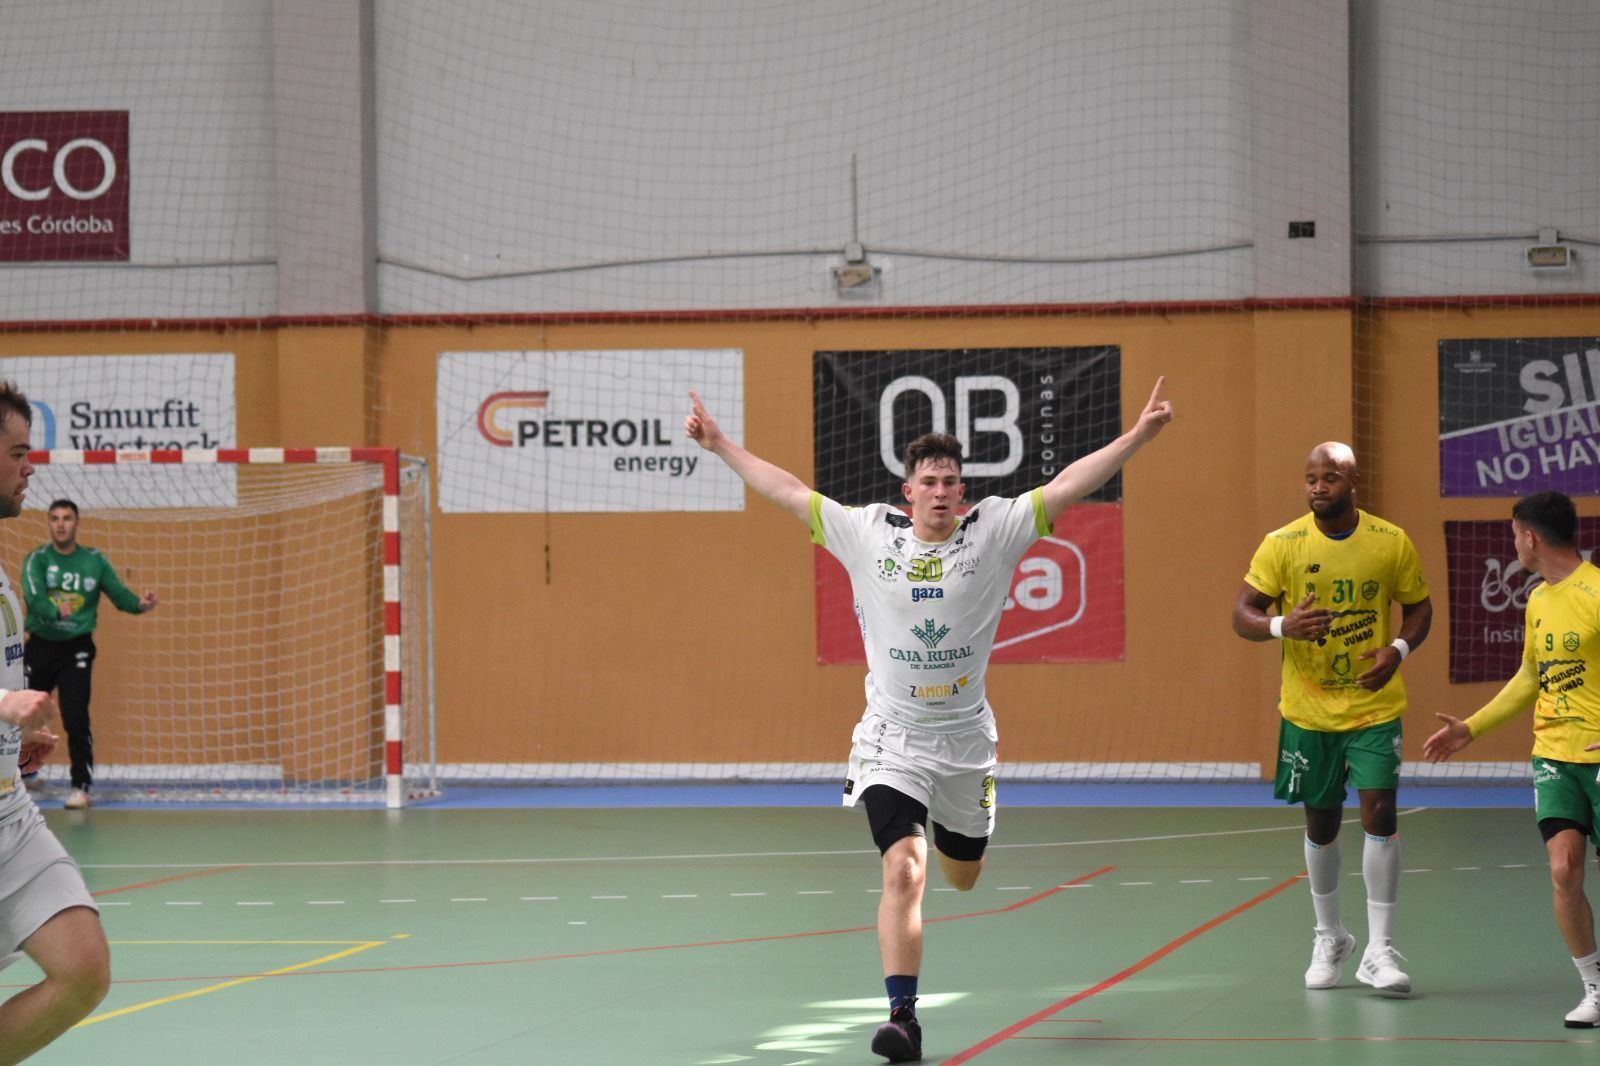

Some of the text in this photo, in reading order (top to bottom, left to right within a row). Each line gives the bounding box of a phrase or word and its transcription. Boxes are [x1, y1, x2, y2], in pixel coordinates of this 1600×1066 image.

[27, 214, 114, 234] Córdoba
[70, 400, 200, 430] Smurfit
[1040, 374, 1055, 476] cocinas
[518, 419, 672, 447] PETROIL
[879, 375, 1024, 479] OB
[613, 453, 698, 477] energy
[1476, 452, 1531, 487] NO
[907, 557, 942, 582] 30
[61, 571, 81, 591] 21
[1332, 579, 1354, 604] 31
[912, 587, 944, 602] gaza
[1343, 628, 1374, 647] JUMBO
[1546, 633, 1554, 652] 9
[889, 645, 974, 662] CAJA RURAL
[923, 662, 956, 670] ZAMORA
[910, 683, 959, 698] ZAMORA
